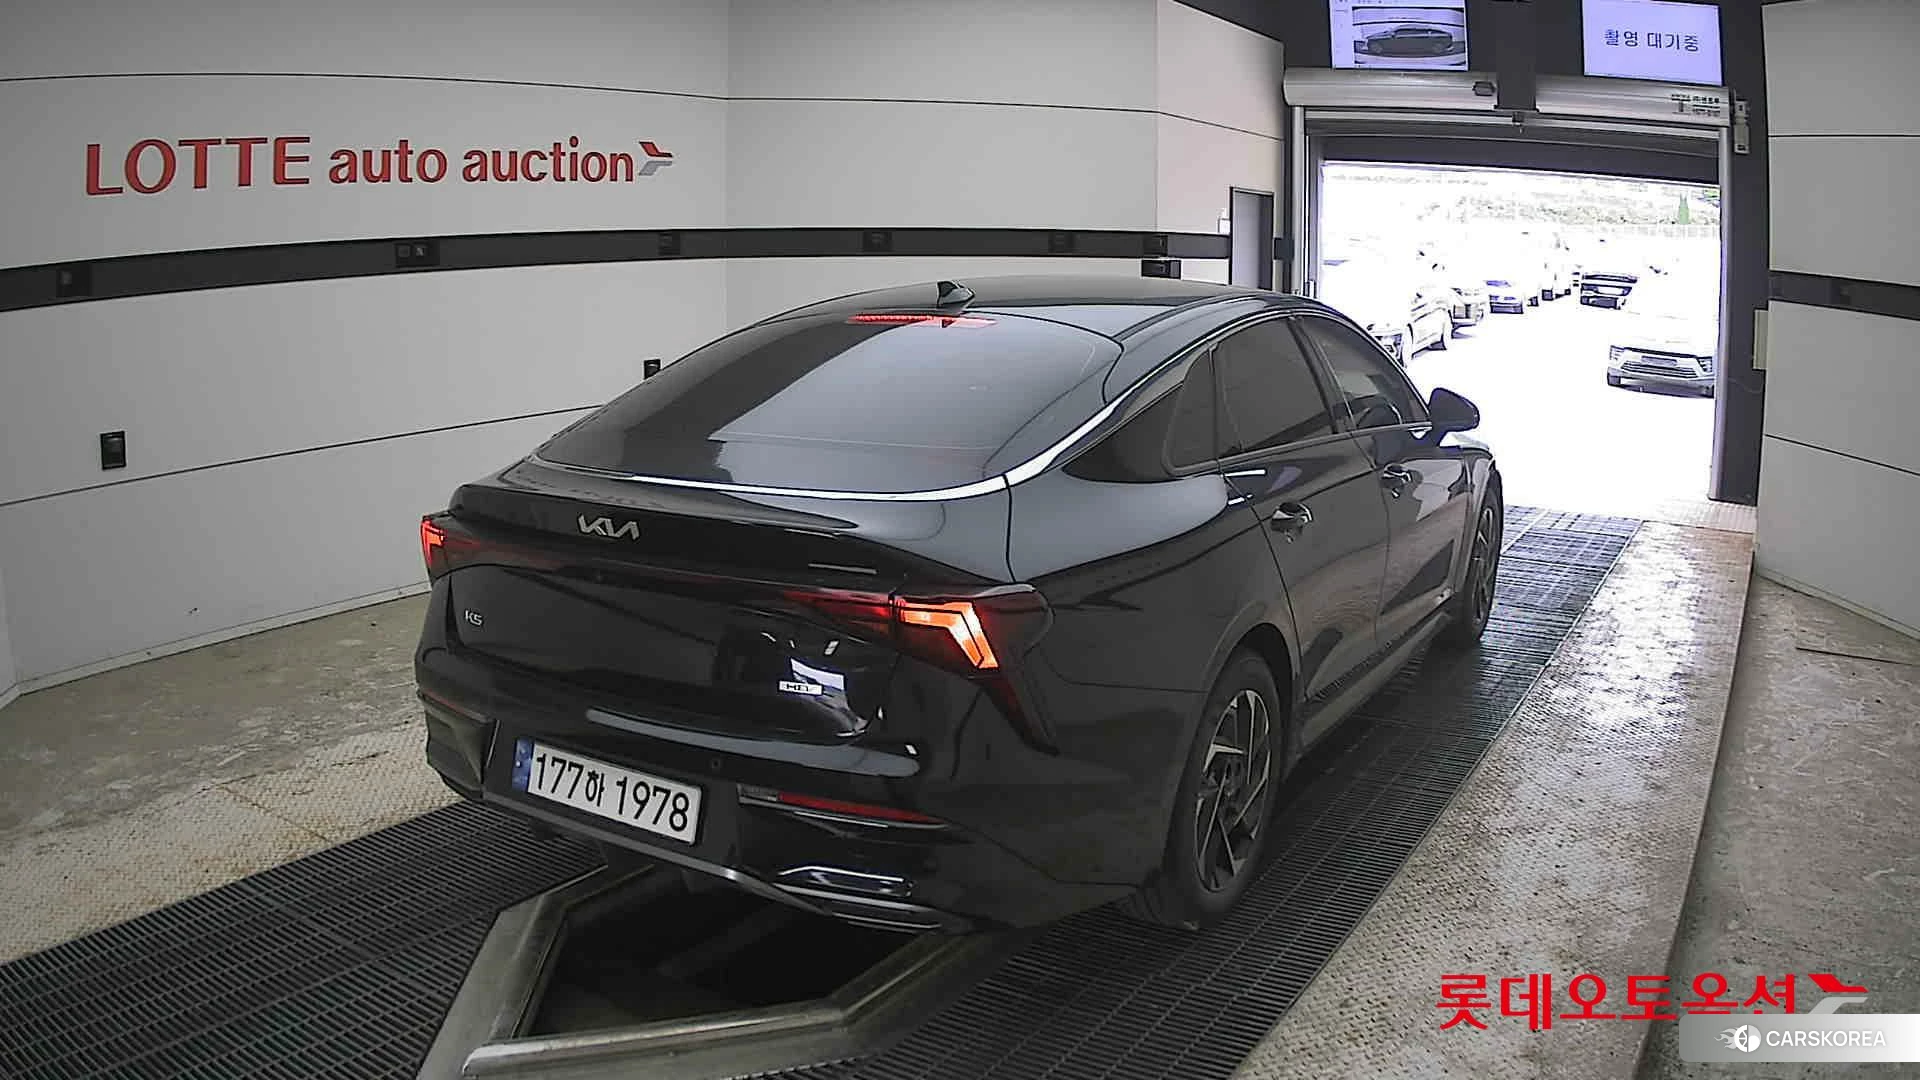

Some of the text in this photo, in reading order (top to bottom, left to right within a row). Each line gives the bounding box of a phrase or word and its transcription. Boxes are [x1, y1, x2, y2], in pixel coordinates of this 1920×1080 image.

[1646, 32, 1699, 52] 대기중
[85, 136, 634, 195] LOTTE auto auction
[578, 514, 641, 541] KIA
[535, 752, 690, 833] 177하 1978
